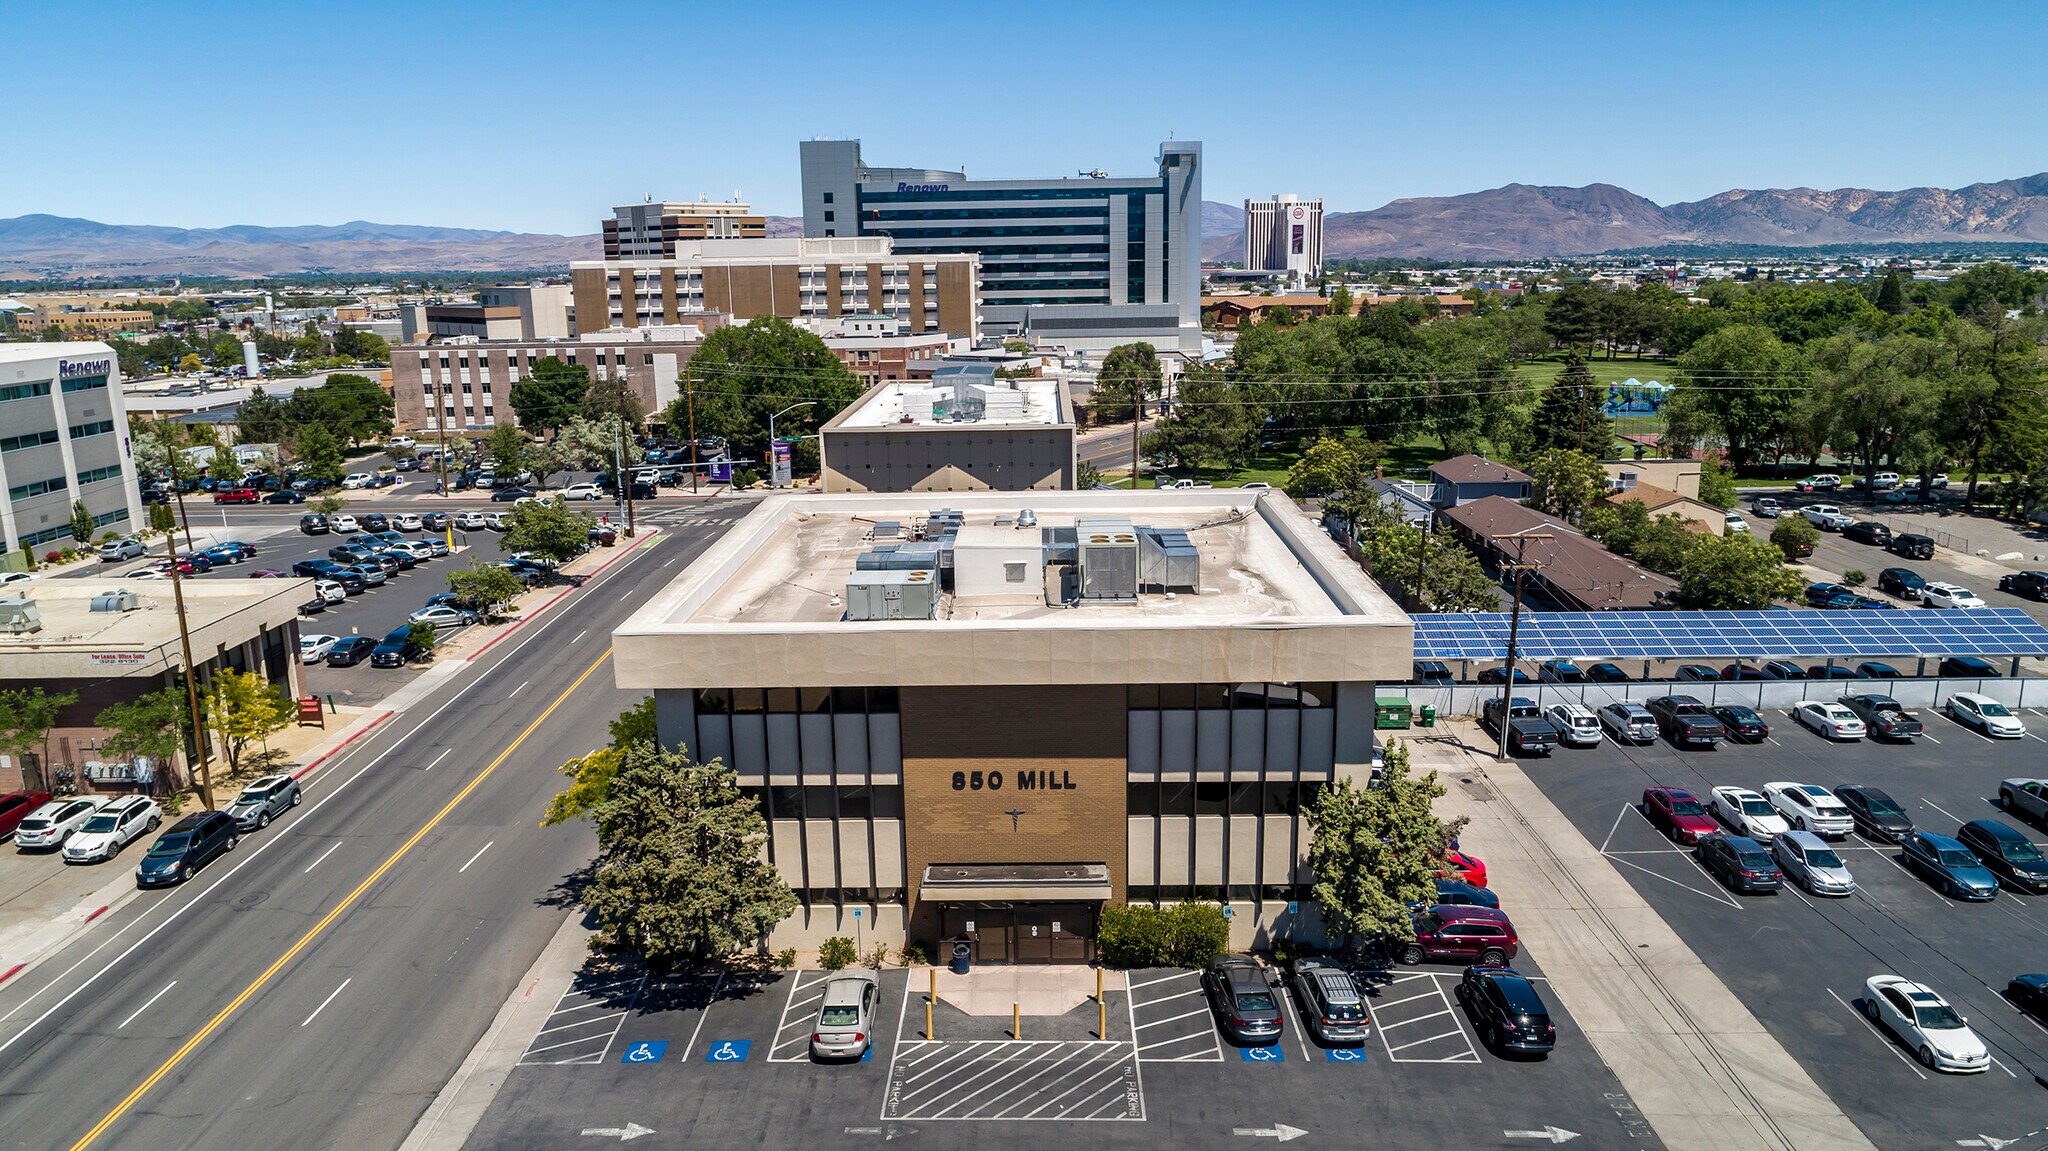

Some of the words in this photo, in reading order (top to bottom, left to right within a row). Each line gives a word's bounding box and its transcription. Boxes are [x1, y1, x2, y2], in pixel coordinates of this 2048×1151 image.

[897, 182, 949, 193] Renown
[59, 360, 110, 374] Renown
[952, 771, 1003, 790] 850
[1017, 771, 1077, 790] MILL
[1125, 1081, 1140, 1117] PARKING
[1603, 1092, 1652, 1138] ENTER
